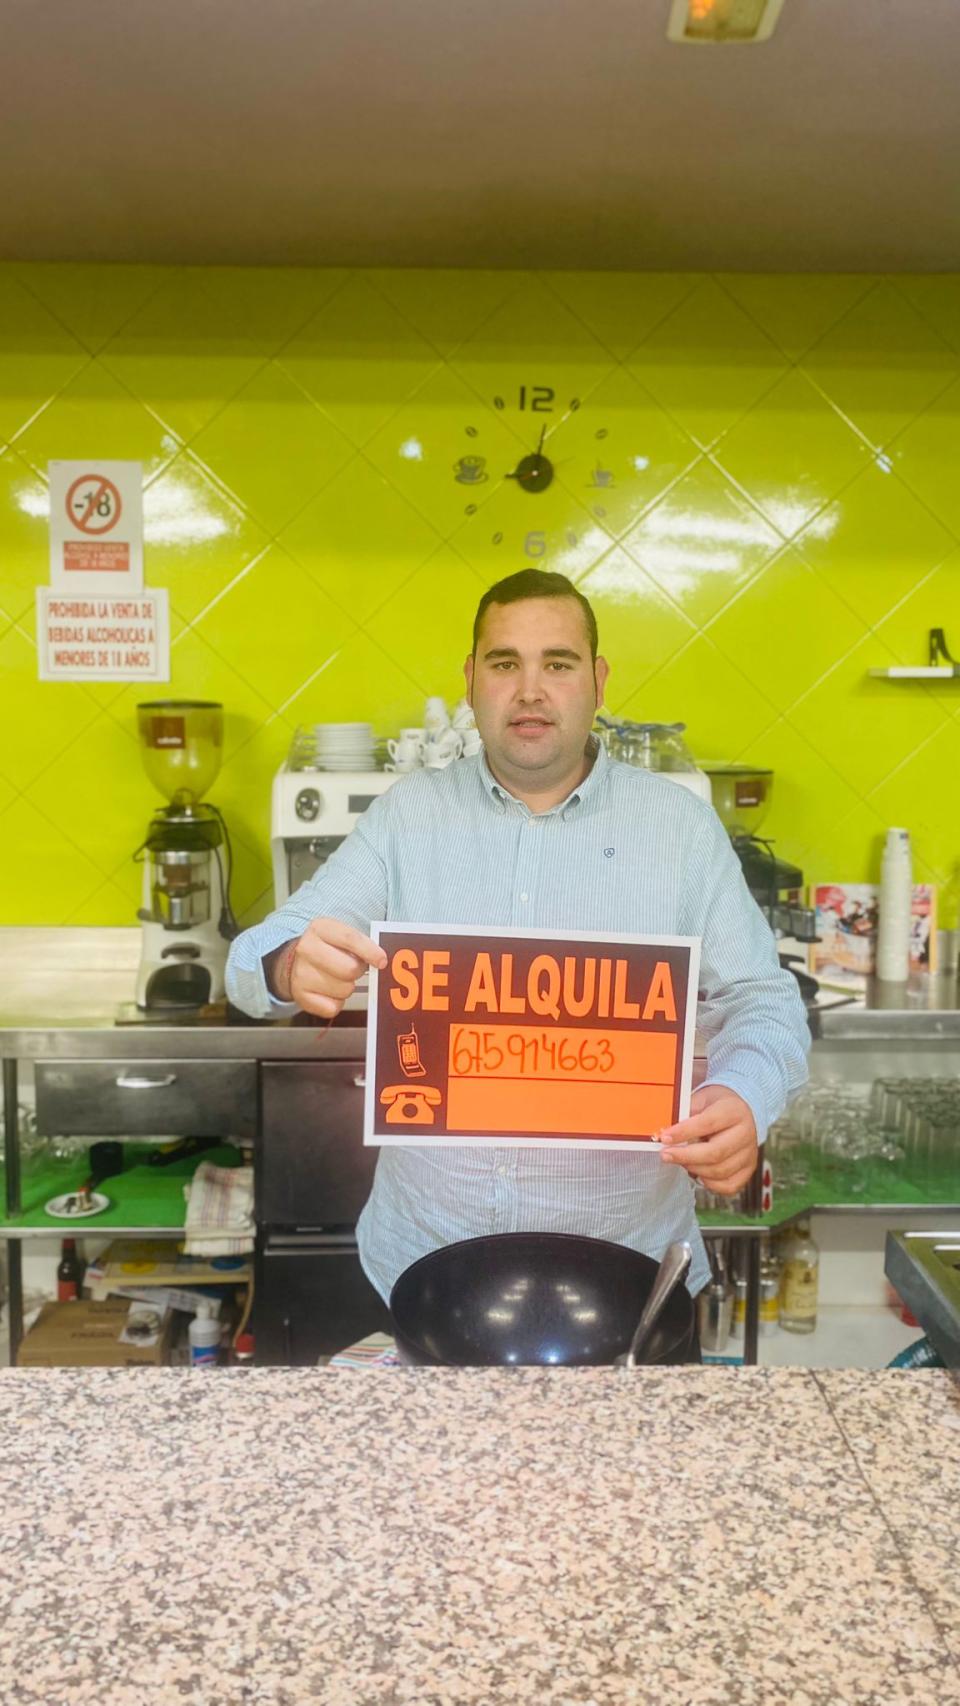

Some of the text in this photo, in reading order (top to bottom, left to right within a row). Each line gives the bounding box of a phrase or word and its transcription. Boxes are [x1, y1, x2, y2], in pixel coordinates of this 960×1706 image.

[519, 385, 555, 412] 12
[524, 531, 545, 558] 6
[48, 602, 152, 618] PROHIBIDA LA VENTA DE
[48, 627, 83, 643] BEBIDAS
[148, 627, 154, 643] A
[55, 650, 95, 666] MENORES
[98, 650, 108, 666] DE
[112, 650, 121, 666] 18
[389, 948, 678, 1021] SE ALQUILA
[452, 1027, 615, 1076] 675914663
